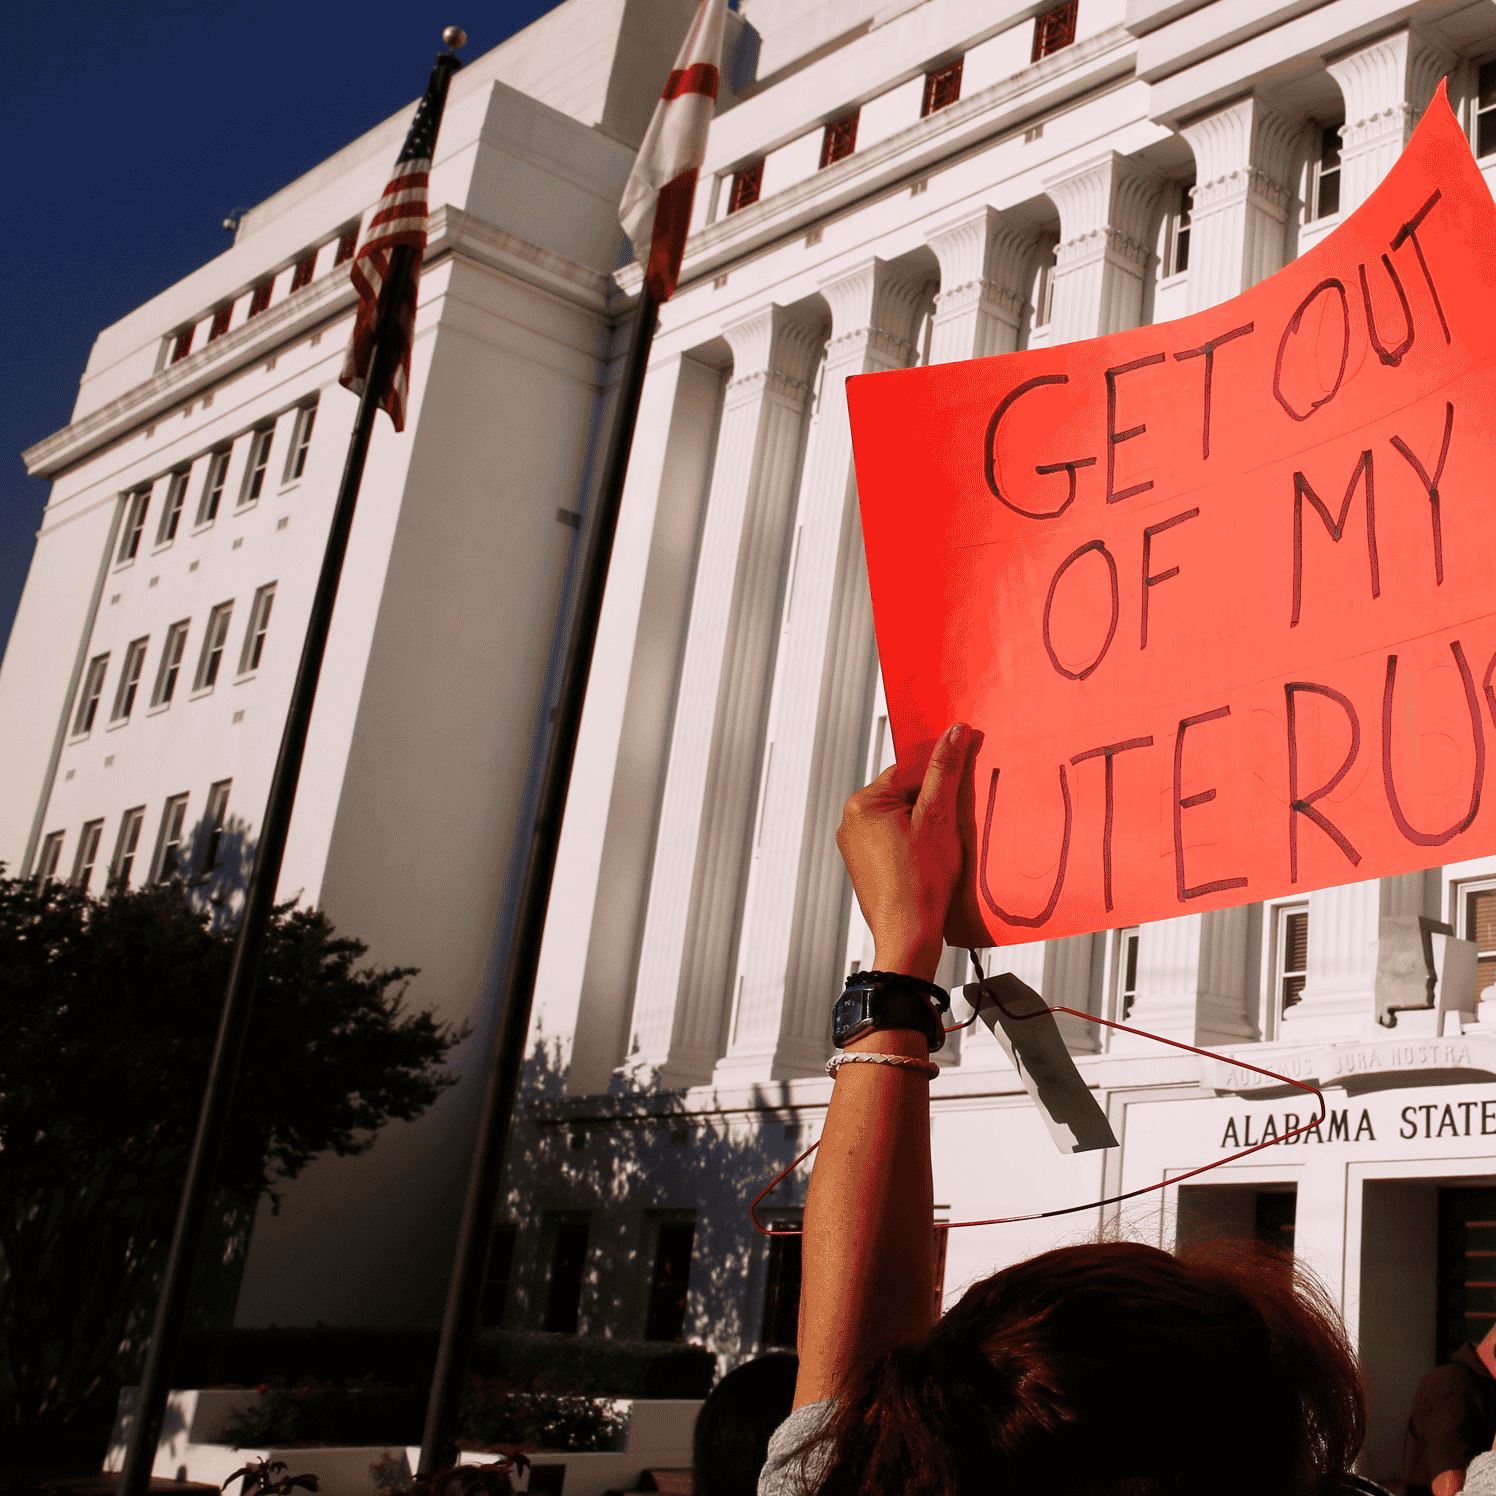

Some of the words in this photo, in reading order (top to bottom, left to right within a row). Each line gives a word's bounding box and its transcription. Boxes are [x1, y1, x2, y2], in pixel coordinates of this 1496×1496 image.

[984, 321, 1256, 520] GET
[1272, 189, 1452, 422] OUT
[1042, 507, 1201, 681] OF
[1290, 402, 1454, 629] MY
[1220, 1107, 1377, 1149] ALABAMA
[1225, 1057, 1313, 1087] AUDEMUS
[1335, 1047, 1382, 1075] JURA
[1391, 1043, 1472, 1067] NOSTRA
